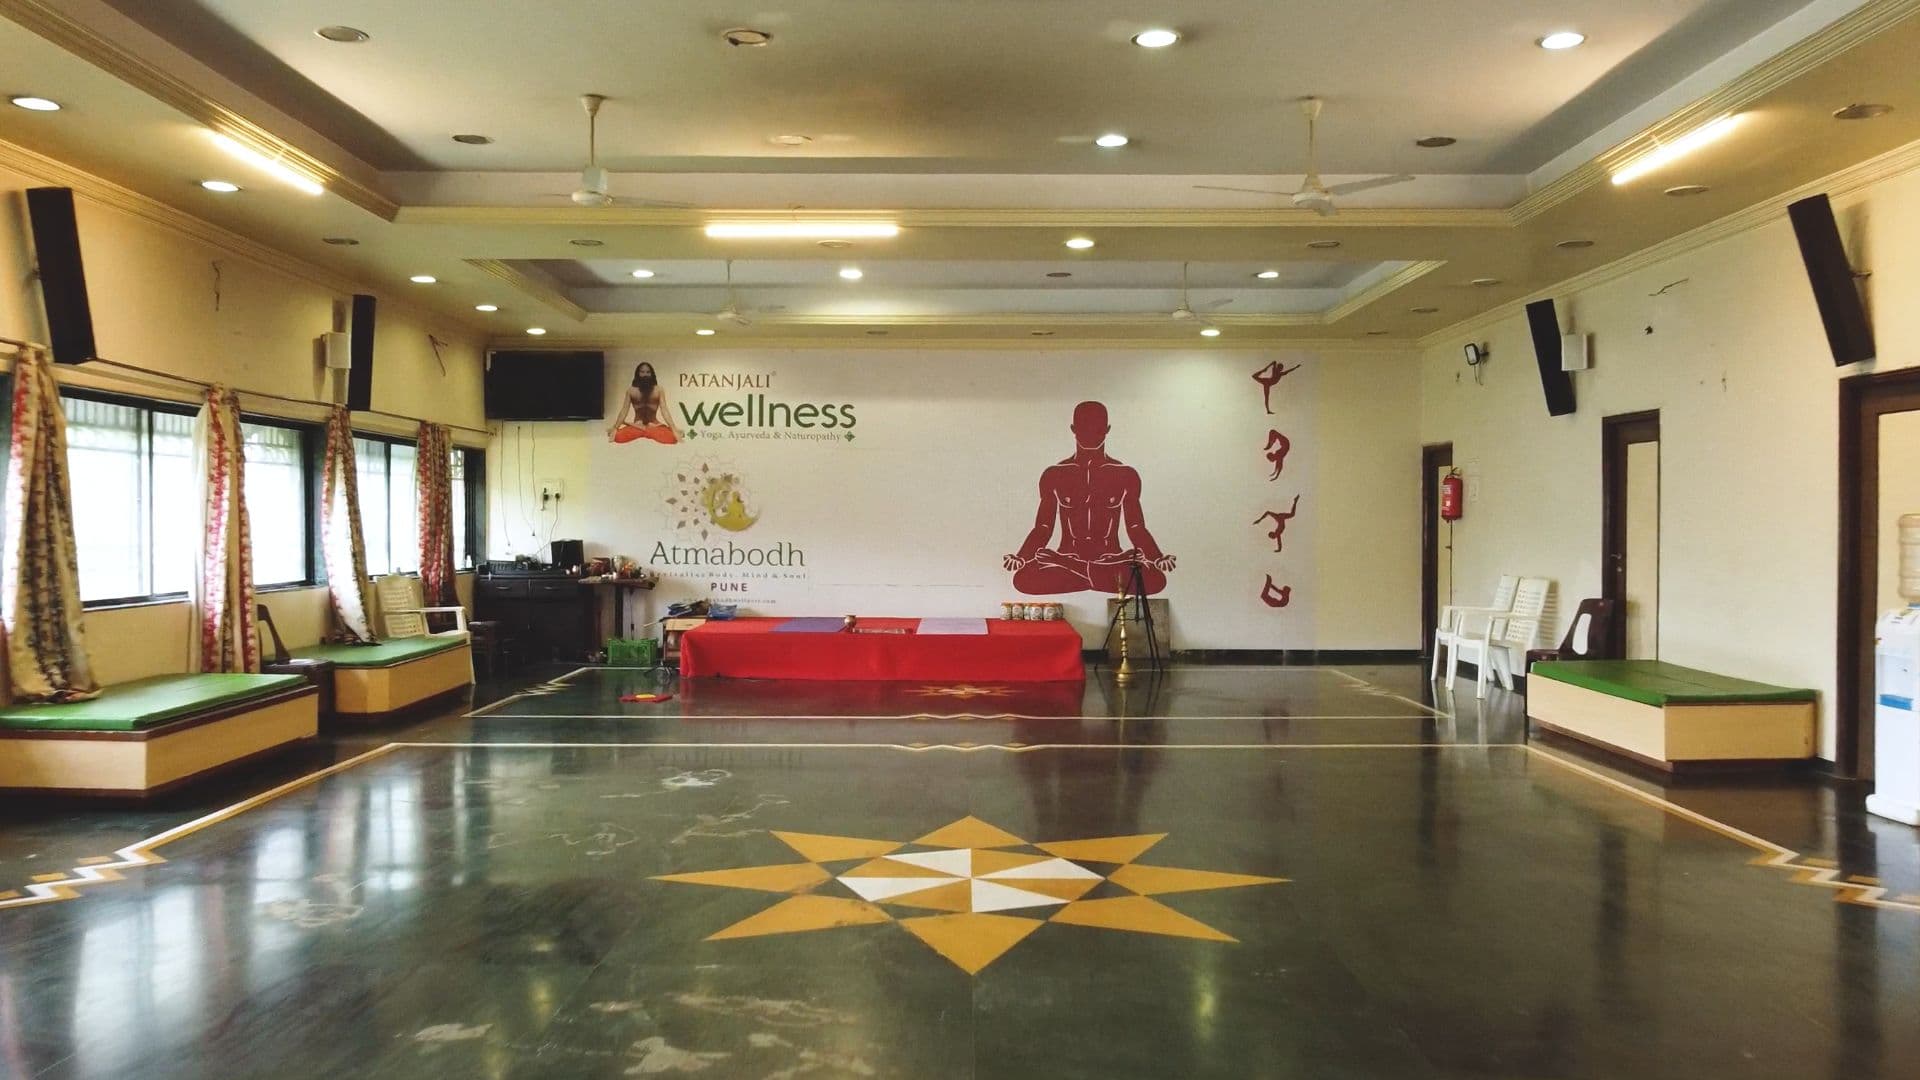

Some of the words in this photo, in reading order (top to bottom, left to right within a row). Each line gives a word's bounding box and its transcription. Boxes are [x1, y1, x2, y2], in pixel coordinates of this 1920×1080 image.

[680, 373, 770, 391] PATANJALI
[679, 394, 857, 428] wellness
[728, 430, 770, 441] Ayurveda
[773, 431, 782, 440] &
[784, 431, 840, 442] Naturopathy
[650, 541, 806, 567] Atmabodh
[710, 583, 749, 592] PUNE
